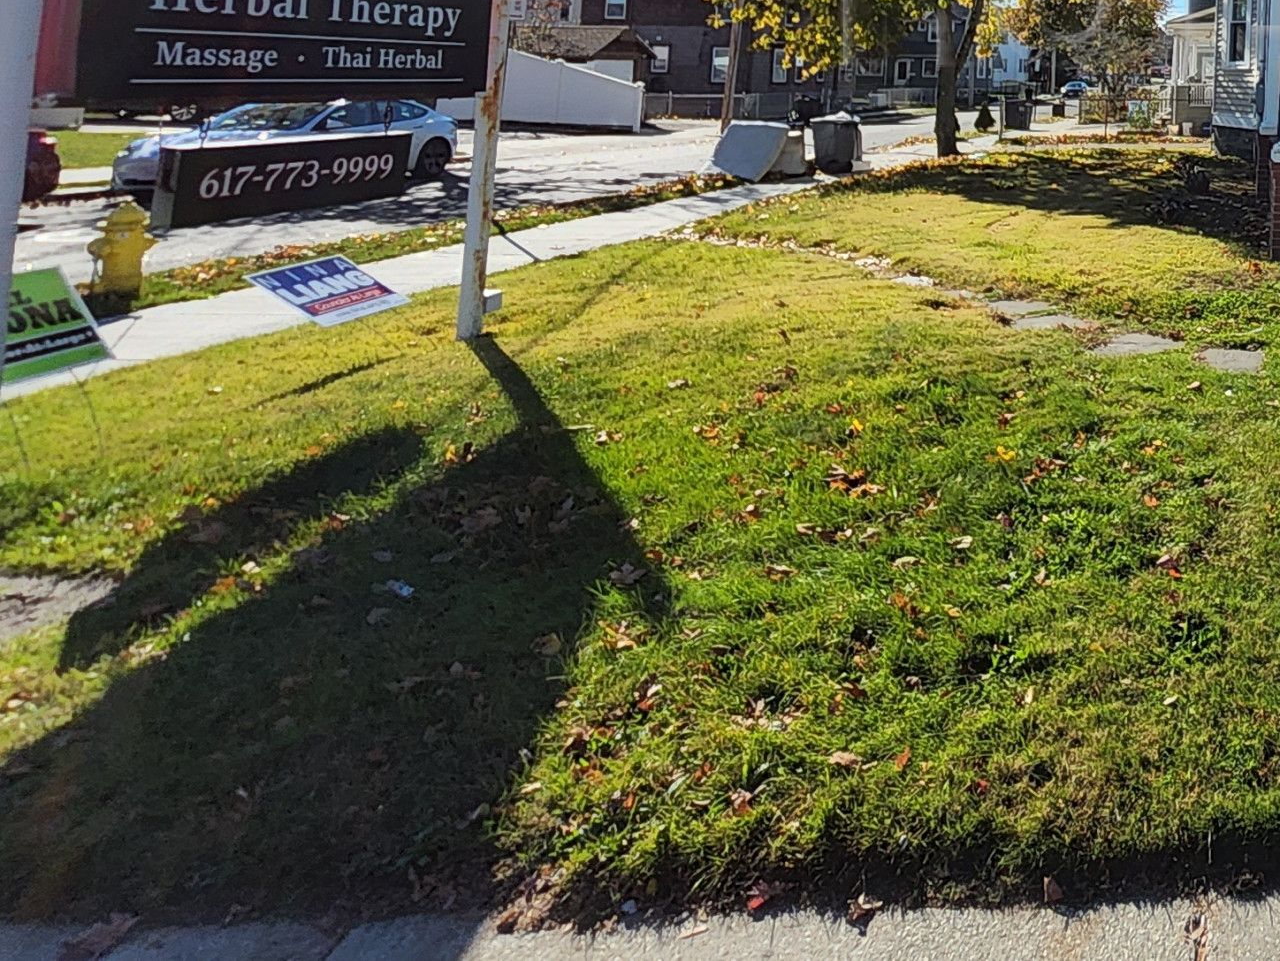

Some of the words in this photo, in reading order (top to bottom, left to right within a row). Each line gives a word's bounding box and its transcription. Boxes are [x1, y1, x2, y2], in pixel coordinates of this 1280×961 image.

[153, 40, 279, 73] Massage
[322, 45, 373, 69] Thai
[377, 48, 444, 70] Herbal
[199, 154, 394, 200] 617-773-9999
[256, 258, 354, 289] NINA
[274, 270, 375, 305] LIANG
